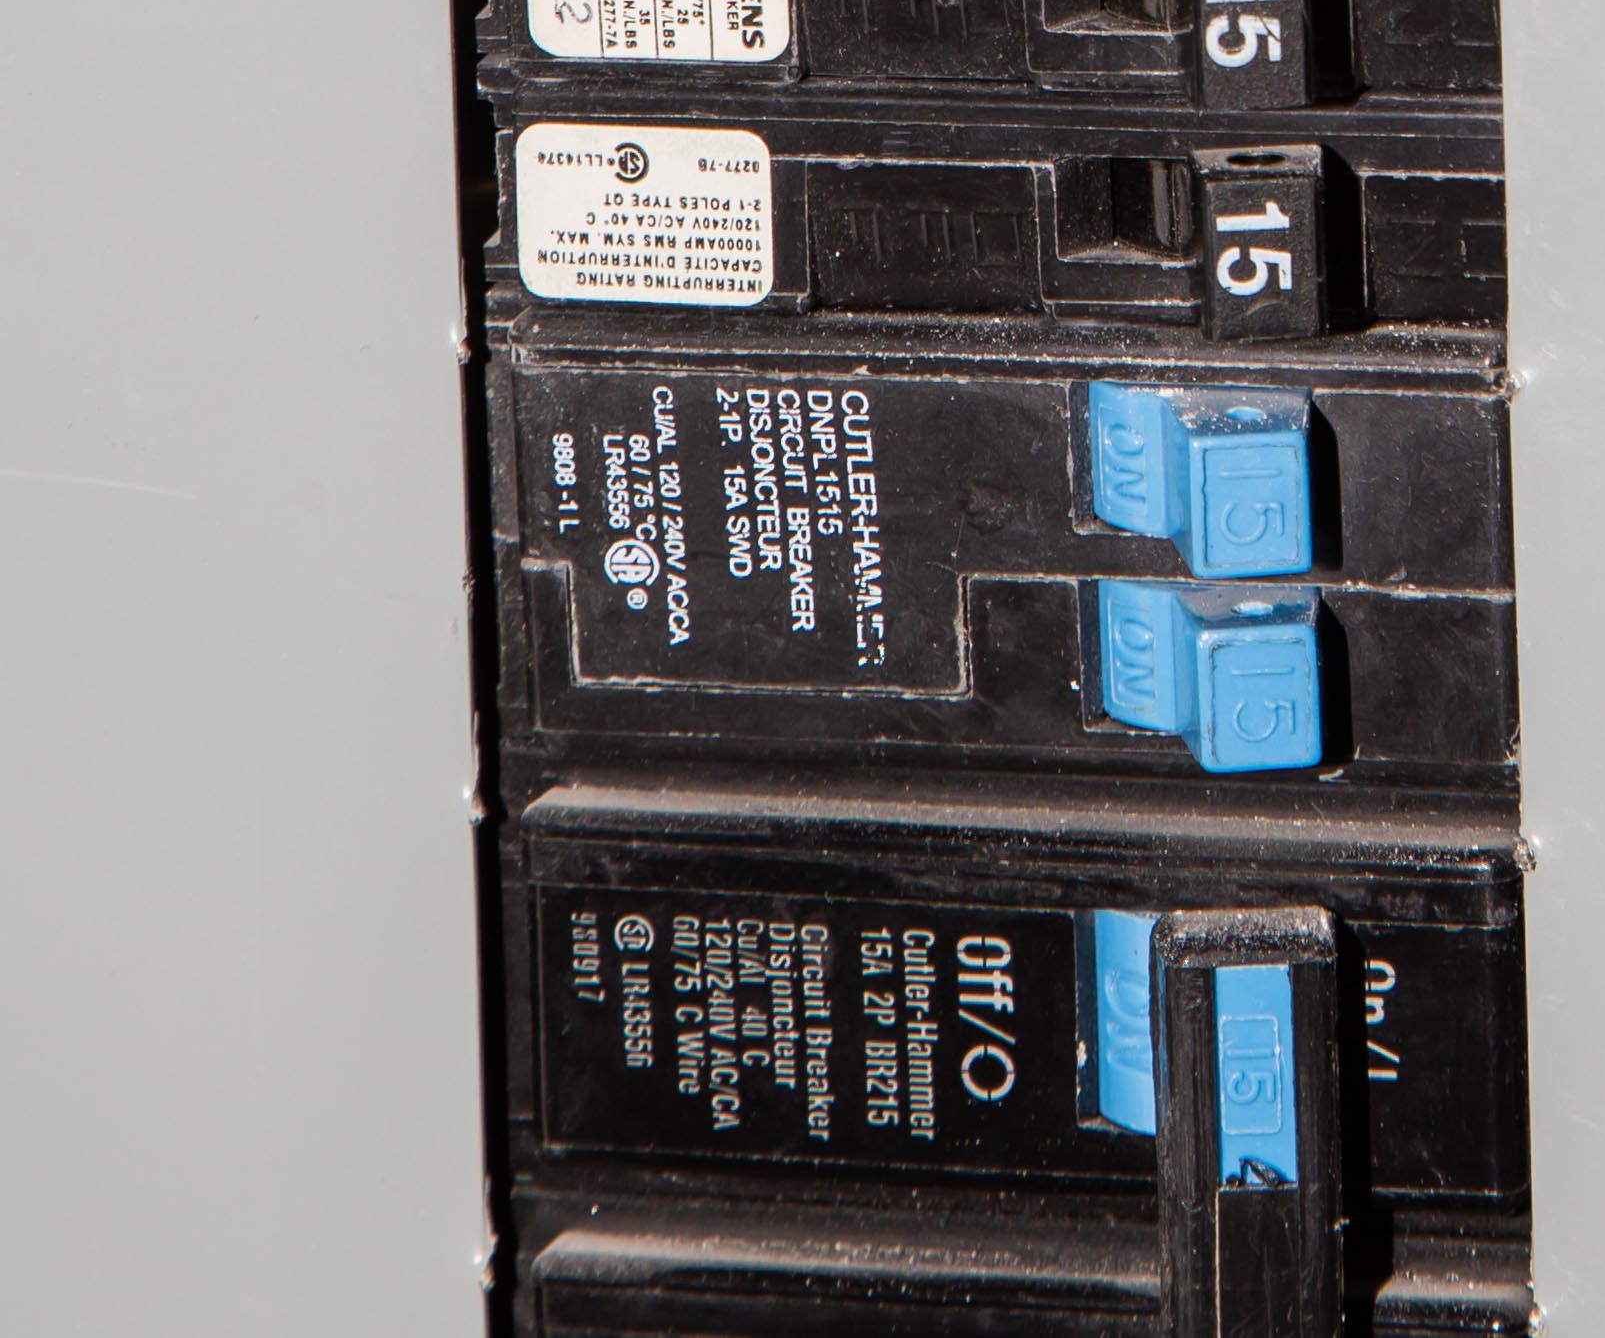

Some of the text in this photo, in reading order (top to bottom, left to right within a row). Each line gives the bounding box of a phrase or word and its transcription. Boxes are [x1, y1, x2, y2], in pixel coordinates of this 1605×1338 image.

[537, 249, 762, 273] CAPACITÉ D'INTERRUPTION
[635, 214, 760, 232] 120/240V AC/CA
[1213, 198, 1291, 297] 15
[576, 271, 762, 293] INTERRUPTING RATING
[602, 434, 631, 529] LR43556
[723, 464, 748, 511] 15A
[746, 388, 783, 570] DISJONCTEUR
[777, 388, 815, 631] CIRCUIT BREAKER
[807, 389, 843, 535] DNPL 1515
[1102, 422, 1144, 505] ON
[1217, 468, 1282, 546] 15
[726, 515, 753, 577] SWD
[1113, 618, 1153, 701] ON
[1229, 666, 1294, 743] 15
[703, 918, 740, 1129] 120/240V AC/CA
[764, 923, 800, 1089] Disjoncteur
[800, 924, 835, 1140] Circuit Breaker
[860, 927, 899, 1124] 15A 2P BR215
[902, 929, 939, 1140] Cutler-Hammer
